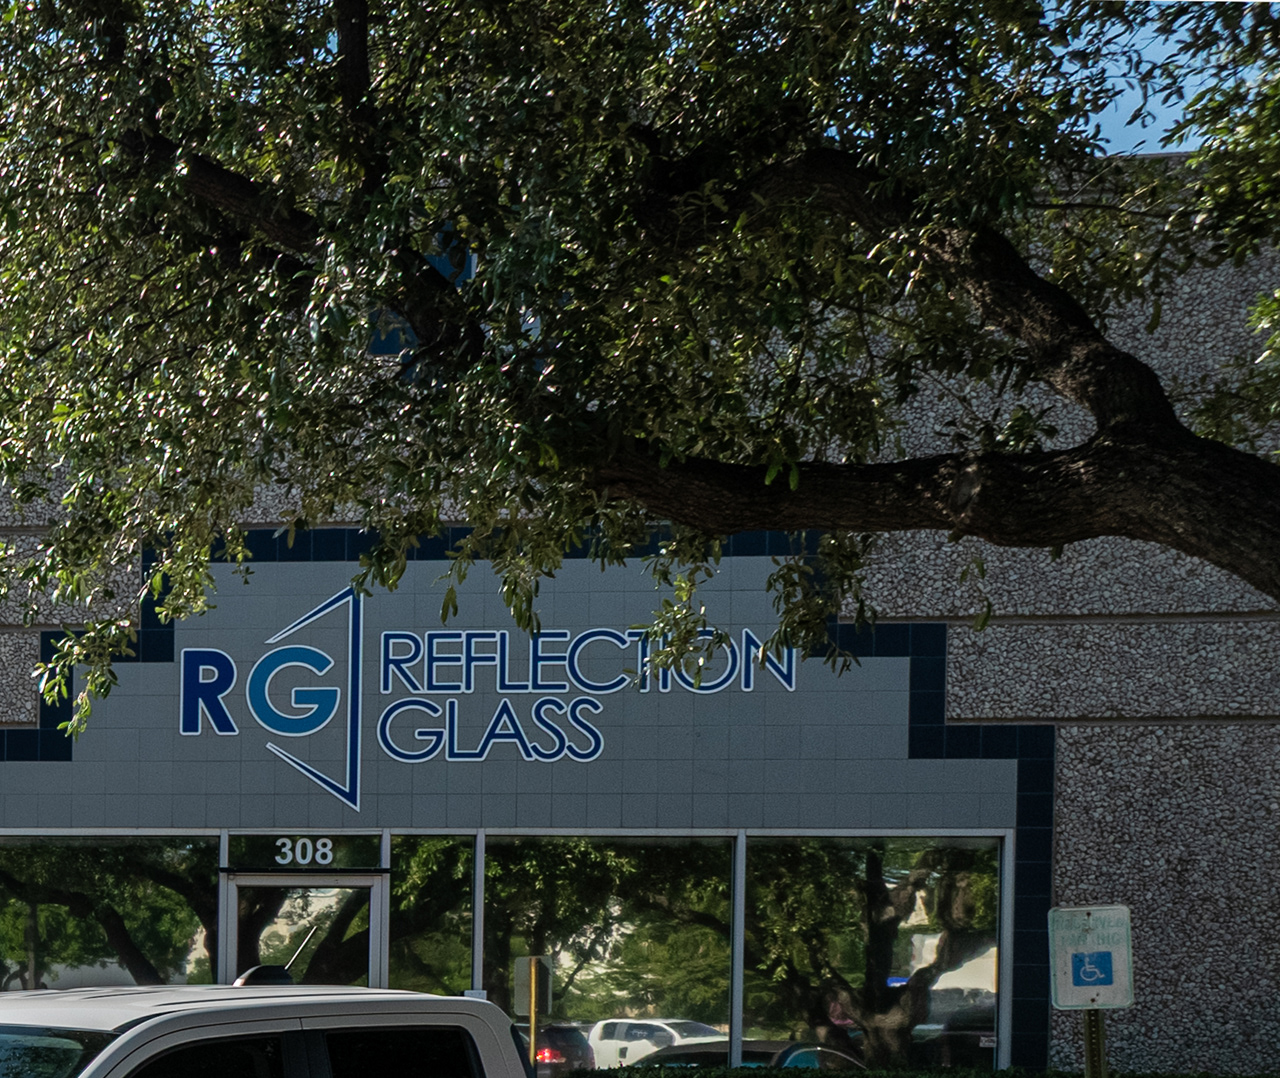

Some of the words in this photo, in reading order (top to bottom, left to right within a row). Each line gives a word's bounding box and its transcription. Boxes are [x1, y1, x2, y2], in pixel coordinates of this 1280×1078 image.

[180, 645, 340, 738] RG
[379, 627, 796, 695] REFLECTION
[377, 696, 605, 763] GLASS
[275, 838, 333, 864] 308
